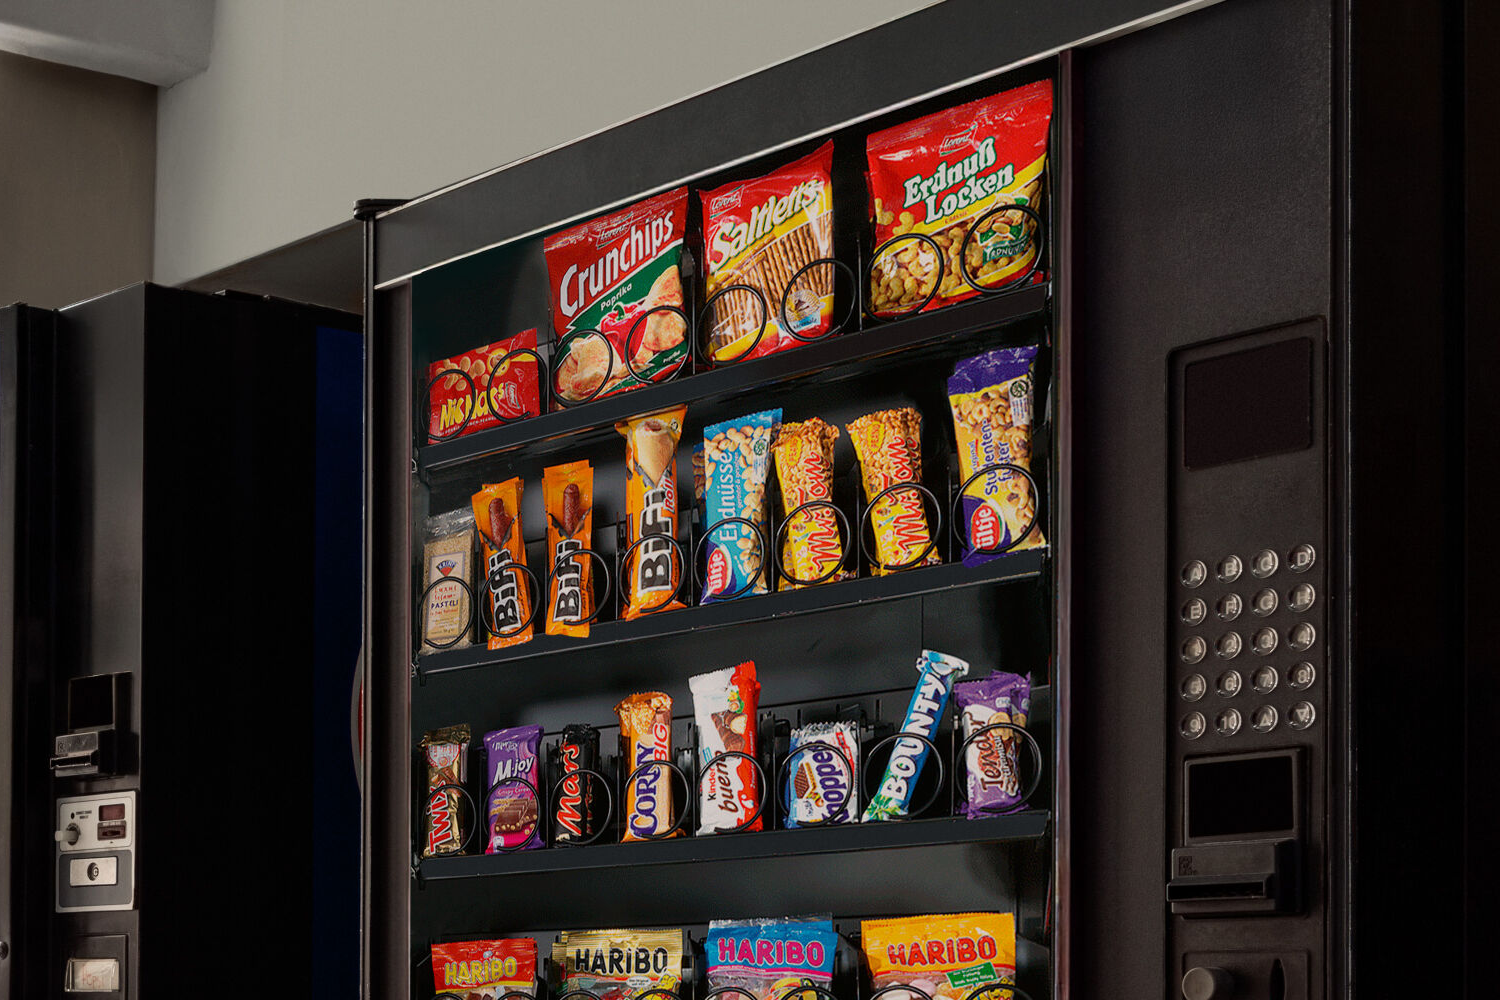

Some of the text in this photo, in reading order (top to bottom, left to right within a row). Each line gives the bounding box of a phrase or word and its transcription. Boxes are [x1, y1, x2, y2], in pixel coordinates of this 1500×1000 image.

[903, 137, 996, 208] Erdnuß
[924, 163, 1015, 224] Locken
[710, 180, 824, 269] Saltletts
[560, 210, 675, 318] Crunchips
[719, 451, 738, 542] Erdnüsse
[977, 507, 993, 550] ültje
[708, 549, 728, 590] ültje
[1190, 567, 1202, 581] A
[1225, 562, 1236, 577] B
[1297, 551, 1310, 567] D
[1190, 604, 1202, 619] E
[1225, 600, 1236, 615] F
[1226, 638, 1236, 653] 2
[1225, 677, 1236, 691] 6
[1261, 673, 1272, 688] 7
[1298, 669, 1309, 684] 8
[654, 722, 669, 762] BIG
[881, 673, 947, 801] BOUNTY
[1190, 715, 1237, 733] 9 10
[557, 742, 583, 837] Mars
[629, 742, 662, 839] CORNY
[444, 956, 518, 986] HARIBO
[574, 946, 670, 975] HARIBO
[717, 937, 825, 968] HARIBO
[887, 935, 998, 967] HARIBO
